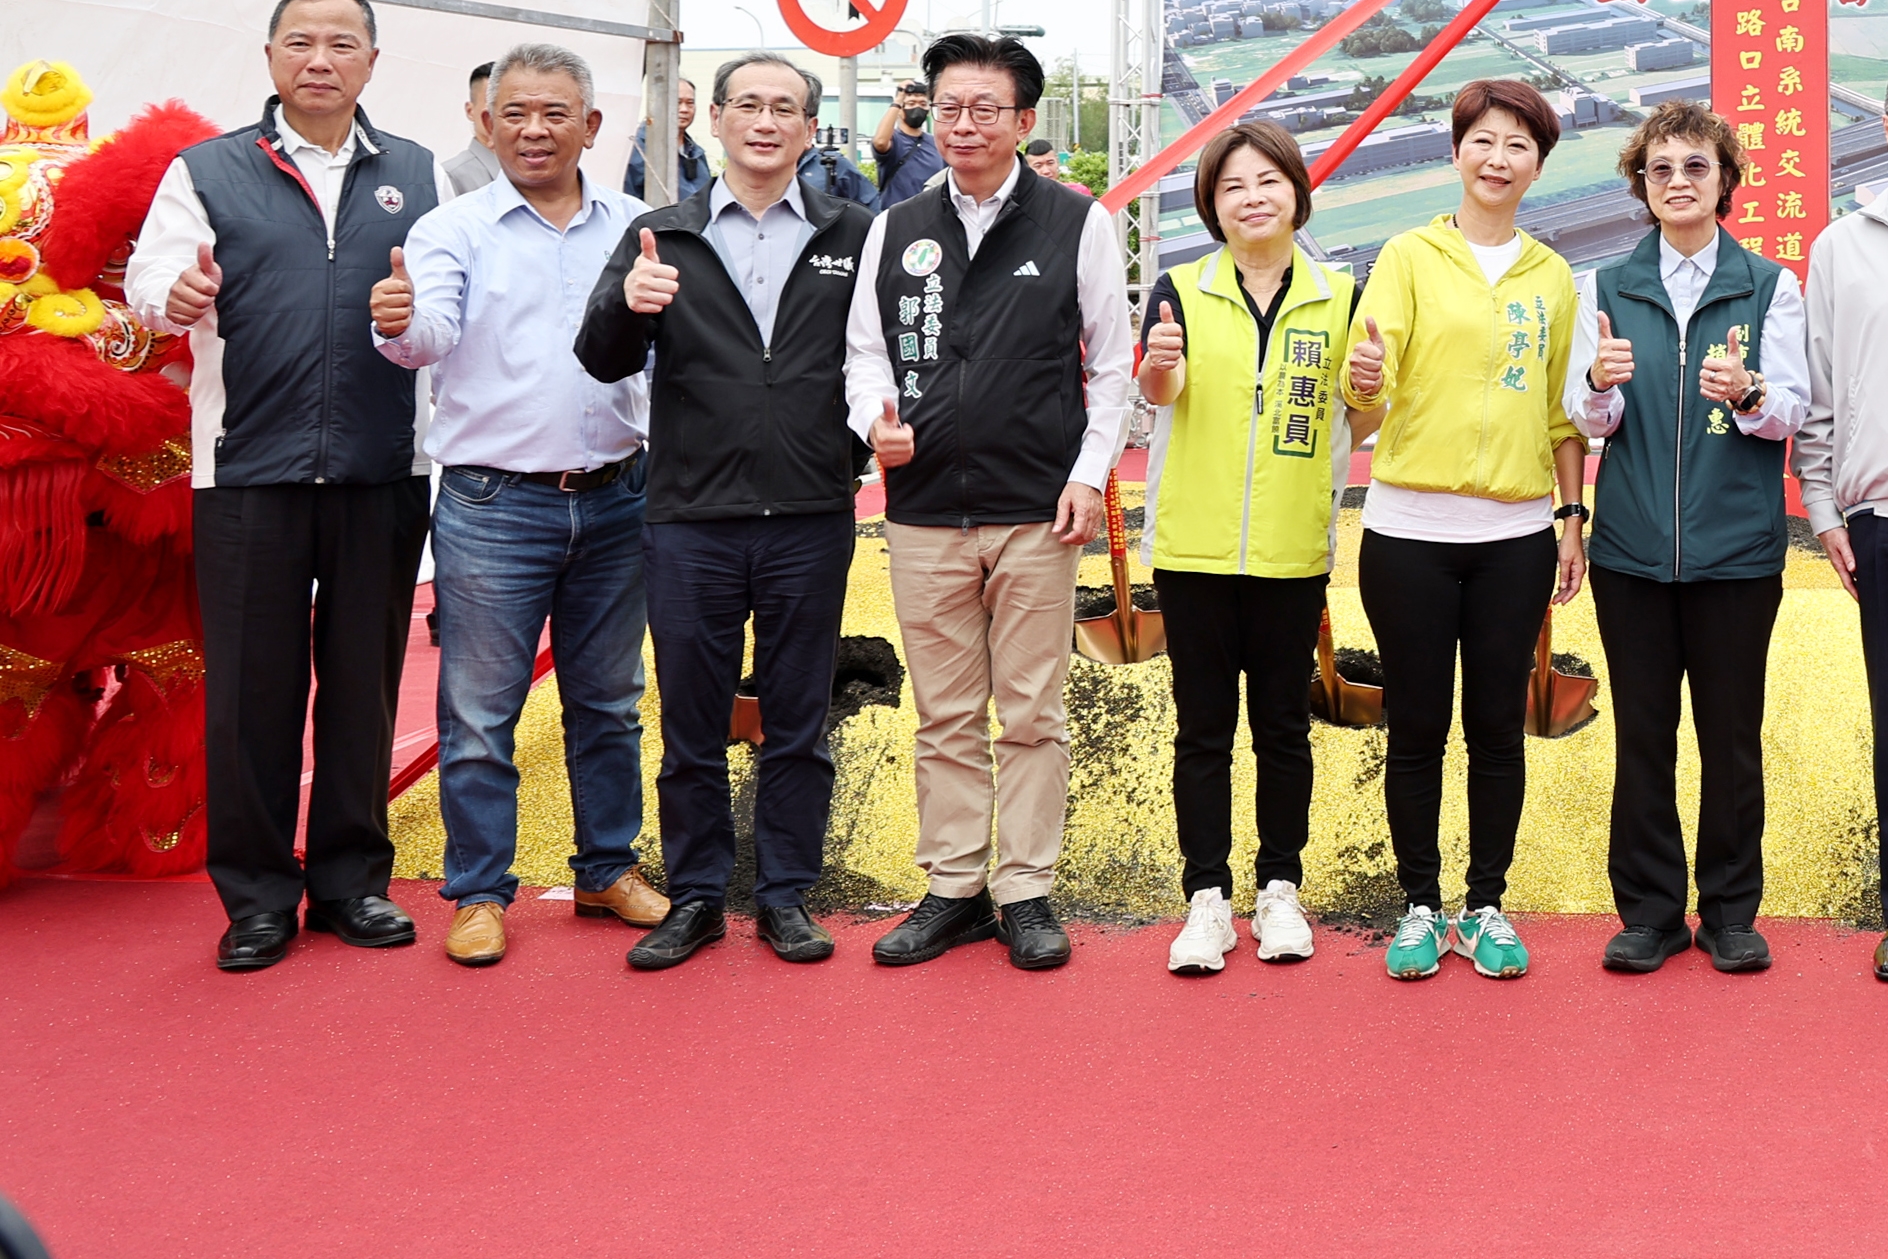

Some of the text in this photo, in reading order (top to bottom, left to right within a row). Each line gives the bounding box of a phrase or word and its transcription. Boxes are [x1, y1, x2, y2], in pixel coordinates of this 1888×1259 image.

[898, 295, 922, 399] 郭國文
[921, 273, 943, 360] 立法委員
[1501, 301, 1531, 393] 陳亭妃
[1535, 295, 1547, 361] 立法委員
[1283, 339, 1322, 447] 賴惠員
[1315, 356, 1332, 422] 立法委員
